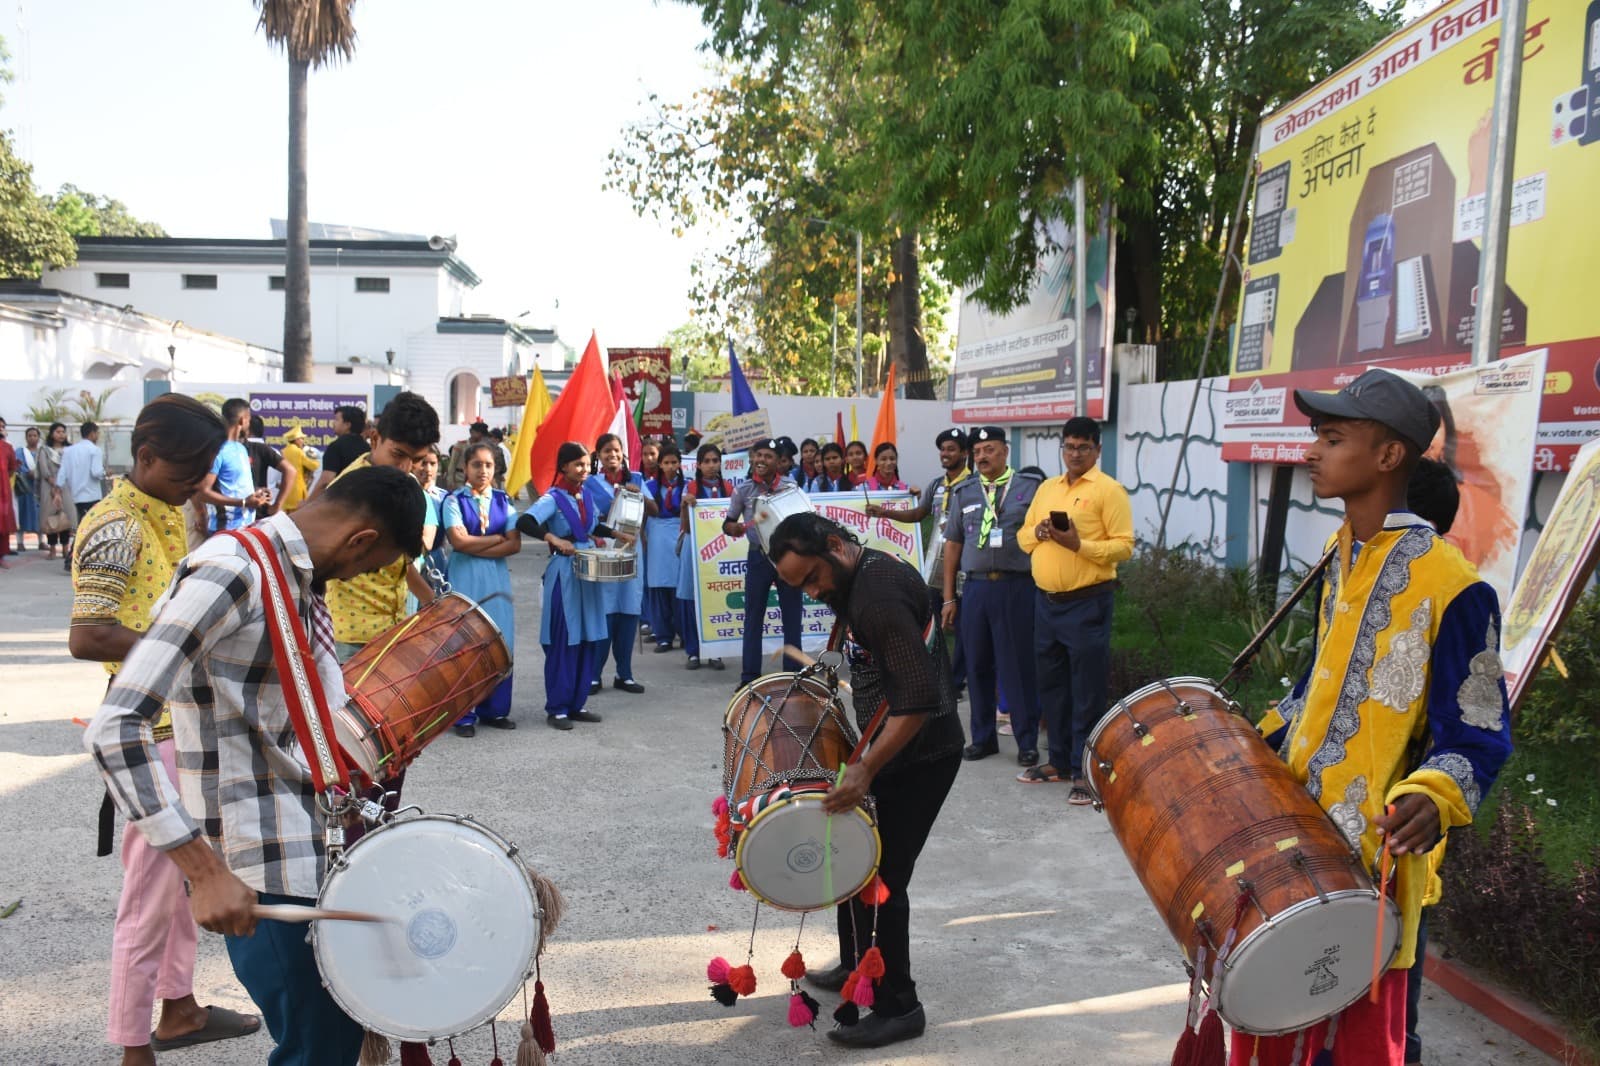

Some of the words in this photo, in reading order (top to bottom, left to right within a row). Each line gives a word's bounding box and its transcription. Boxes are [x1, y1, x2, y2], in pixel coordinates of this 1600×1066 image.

[1274, 75, 1362, 142] लोकसभा
[1367, 38, 1423, 88] आम
[1299, 142, 1366, 199] अपना
[1032, 324, 1070, 346] जानकारी
[1538, 429, 1600, 437] w.voter.ec
[724, 459, 744, 470] 2024
[698, 508, 715, 519] वोट
[826, 505, 872, 533] भागलपुर
[876, 516, 914, 555] (बिहार)
[700, 533, 728, 562] भारत
[706, 580, 743, 592] मतदान
[709, 611, 732, 623] सारे
[717, 628, 735, 637] घर
[809, 621, 826, 632] दो.
